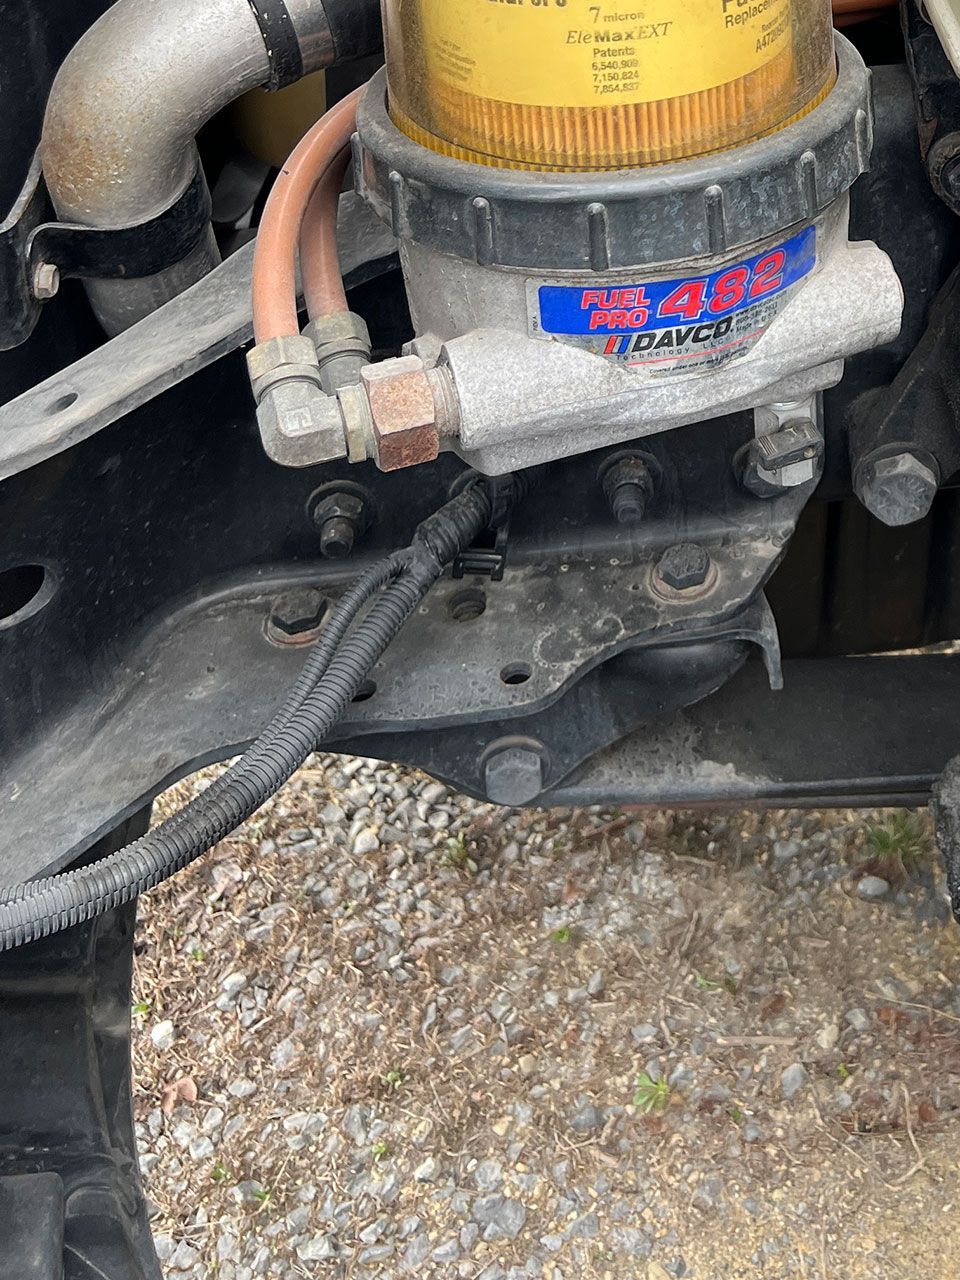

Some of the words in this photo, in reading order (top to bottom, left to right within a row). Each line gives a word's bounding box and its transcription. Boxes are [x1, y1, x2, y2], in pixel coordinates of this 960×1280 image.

[589, 6, 601, 24] 7
[603, 11, 645, 23] micron
[592, 48, 636, 58] Patents
[658, 248, 787, 322] 482
[580, 287, 651, 311] FUEL
[588, 309, 649, 331] PRO
[631, 317, 733, 354] DAVCO
[615, 347, 690, 362] Technology
